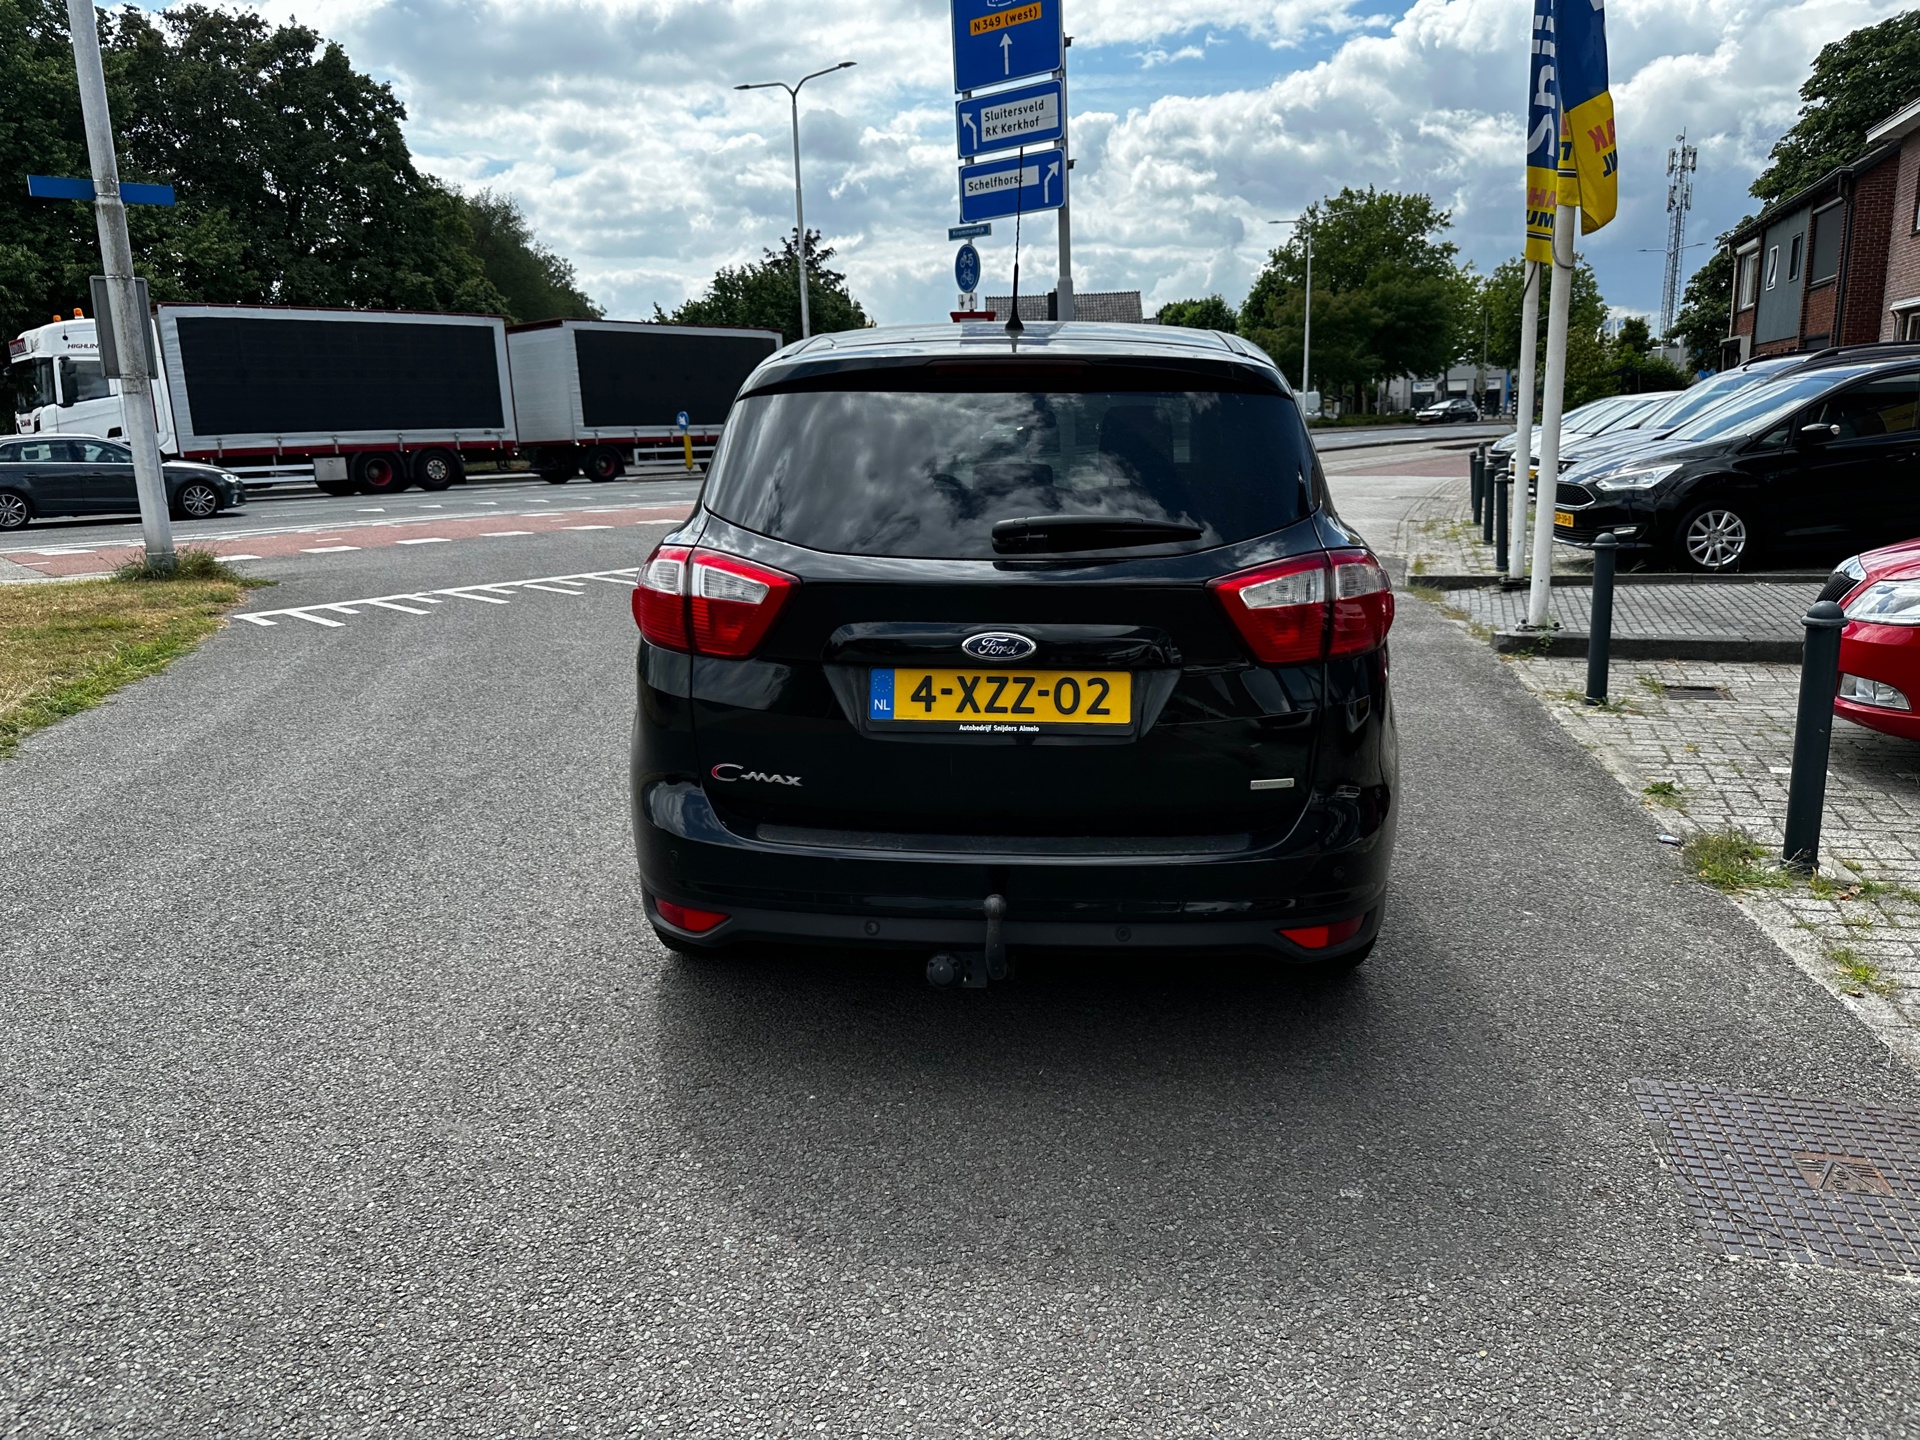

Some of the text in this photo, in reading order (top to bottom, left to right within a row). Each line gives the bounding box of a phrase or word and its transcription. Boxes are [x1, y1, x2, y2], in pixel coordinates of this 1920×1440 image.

[974, 6, 1038, 32] N 349 (west)
[984, 100, 1045, 122] Sluitersveld
[985, 116, 1040, 137] RK Kerkhof
[978, 637, 1019, 655] Ford
[874, 699, 891, 711] NL
[910, 675, 1110, 716] 4-XZZ-02
[959, 724, 992, 732] Autobedrijf
